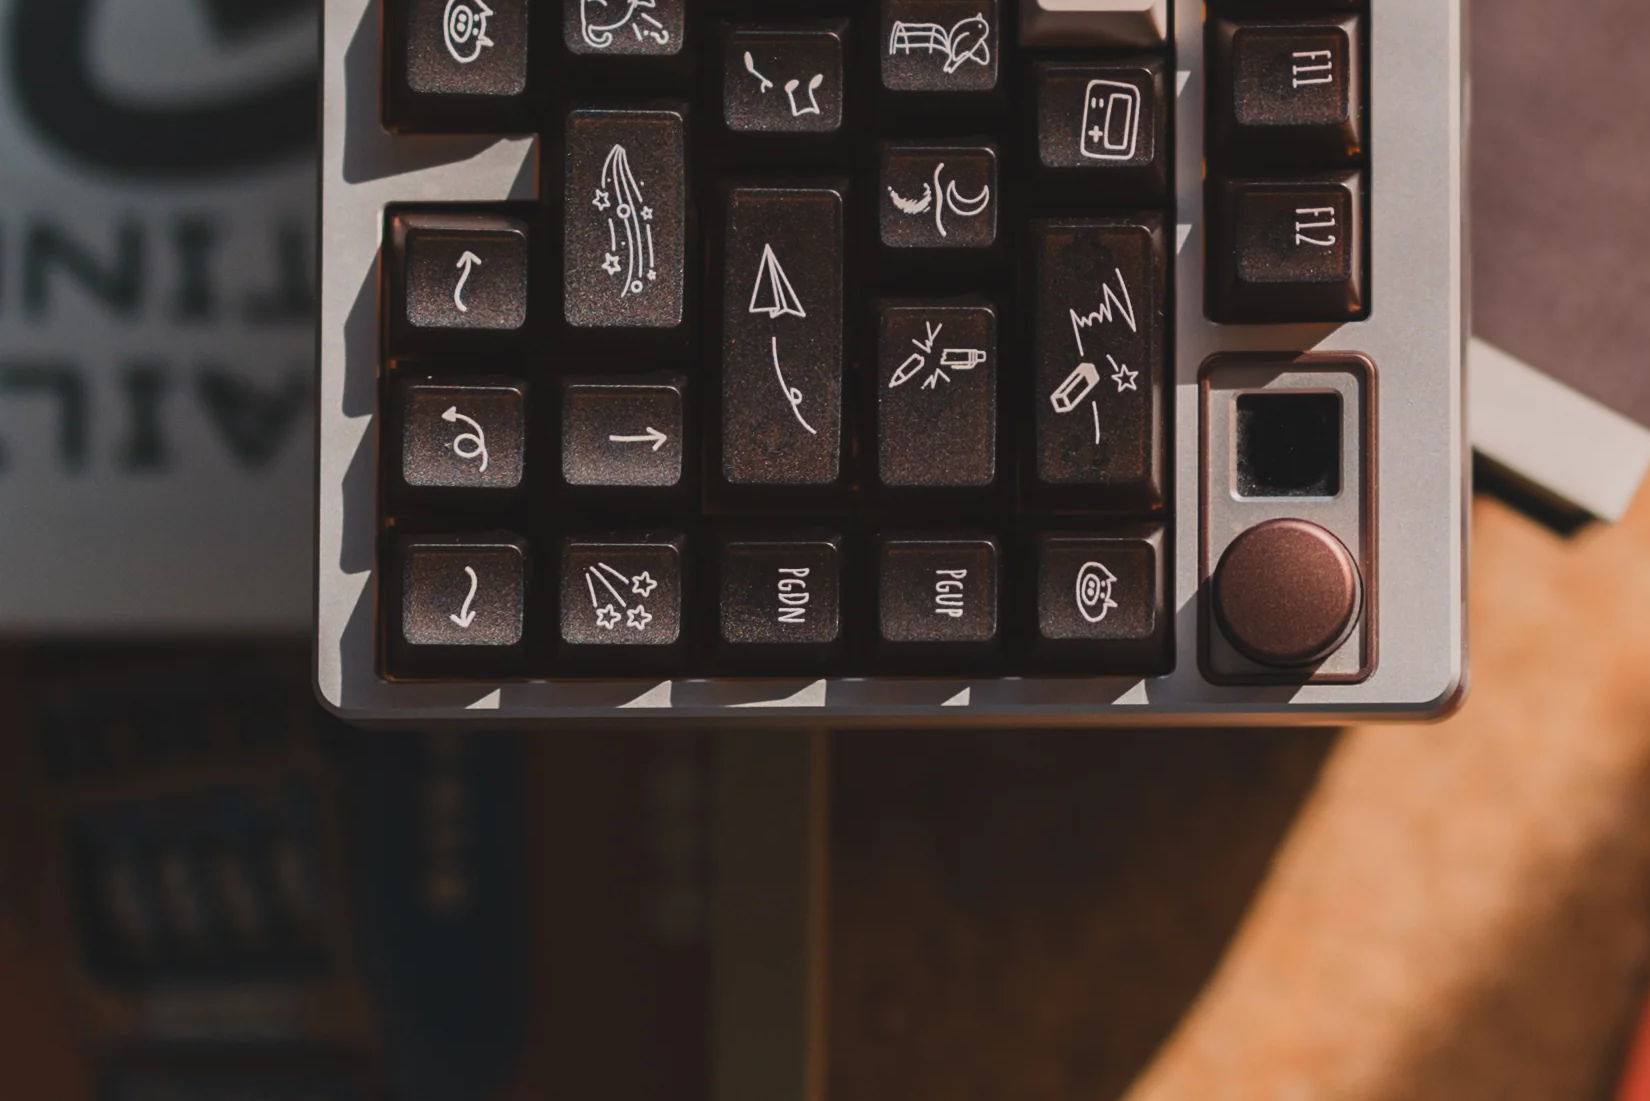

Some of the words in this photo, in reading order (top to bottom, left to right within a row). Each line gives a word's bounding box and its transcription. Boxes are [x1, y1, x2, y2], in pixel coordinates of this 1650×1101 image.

[1292, 49, 1333, 89] F11
[1294, 206, 1337, 248] F12
[776, 566, 811, 625] PGDN
[934, 567, 968, 619] PGUP
